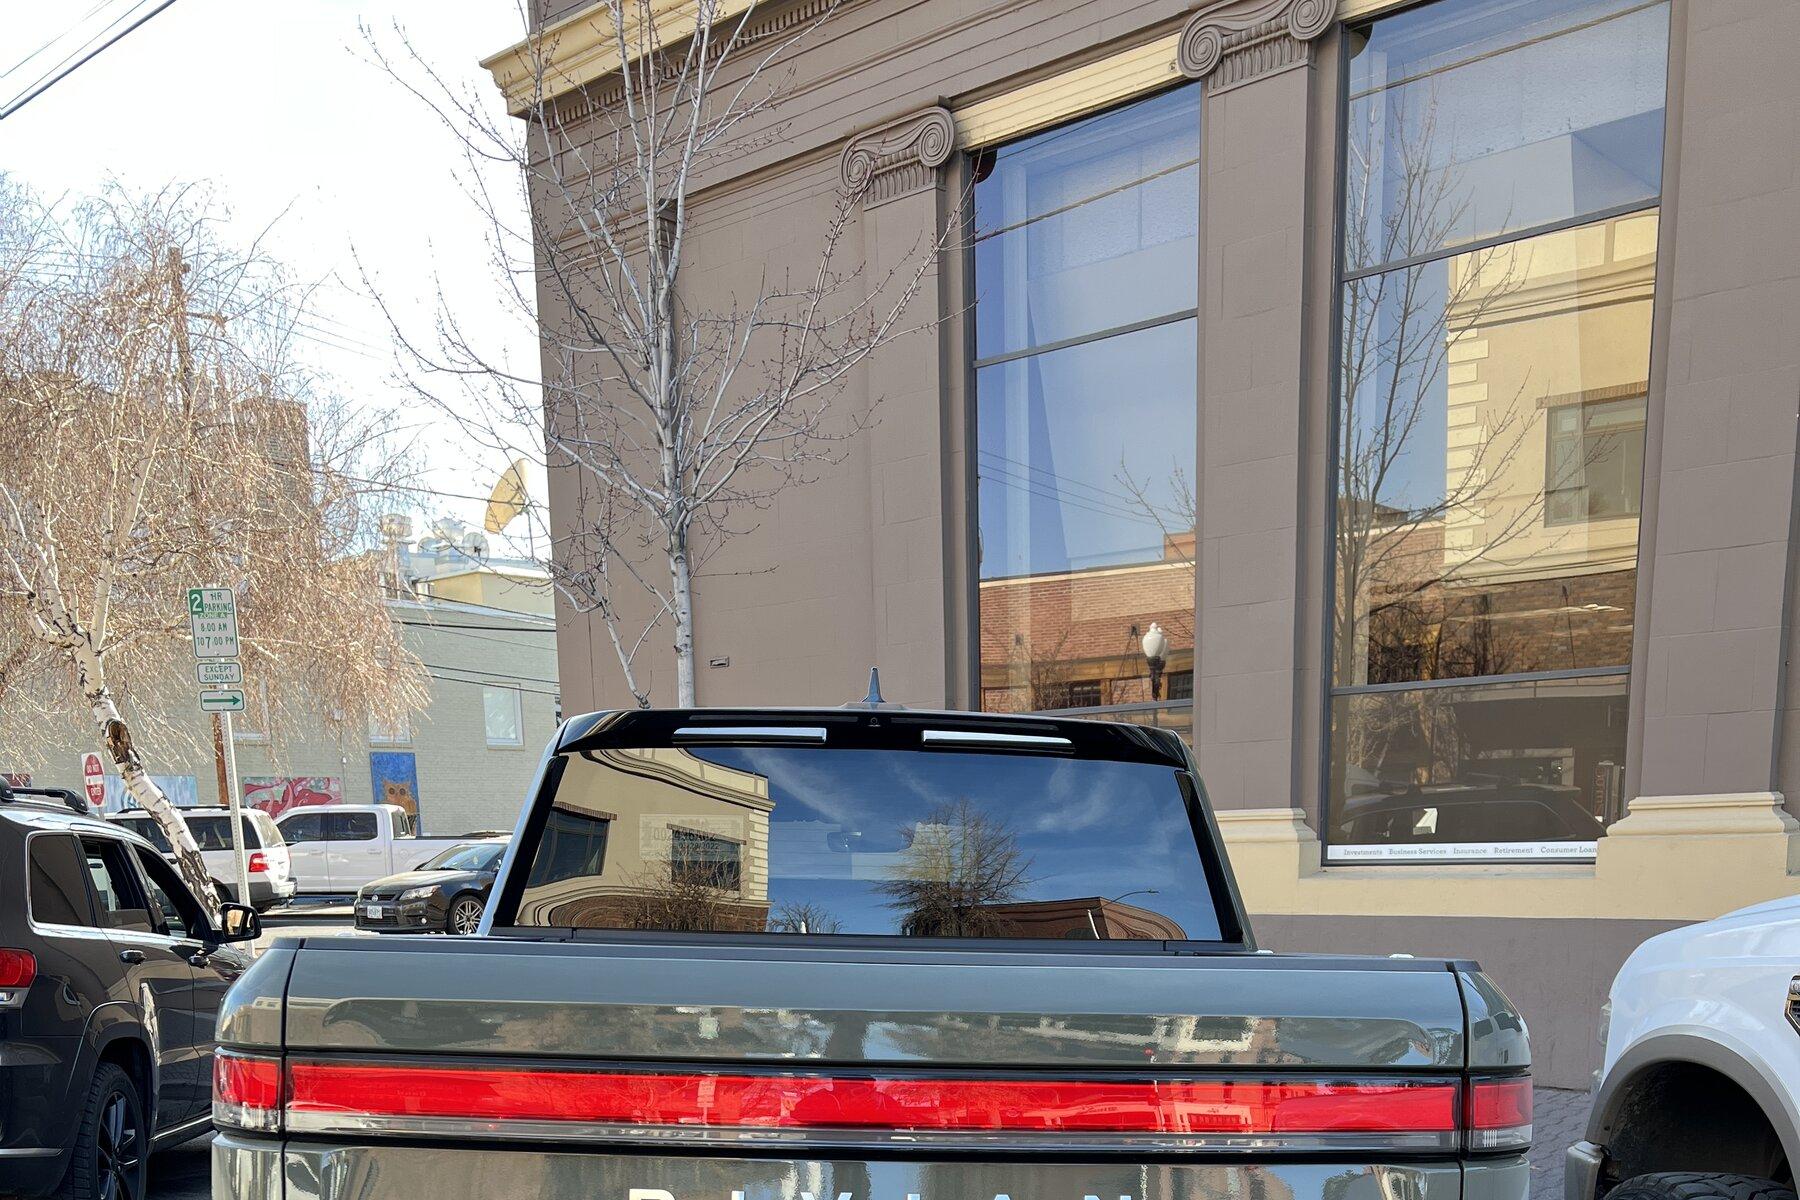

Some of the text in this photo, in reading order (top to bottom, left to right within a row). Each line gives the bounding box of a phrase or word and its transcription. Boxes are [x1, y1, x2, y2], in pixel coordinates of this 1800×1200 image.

[210, 592, 223, 600] HR
[191, 593, 202, 612] 2
[204, 602, 232, 611] PARKING
[218, 623, 227, 631] AM
[225, 637, 234, 645] PM
[205, 665, 232, 673] EXCEPT
[204, 673, 235, 681] SUNDAY
[1494, 846, 1533, 854] Retirement
